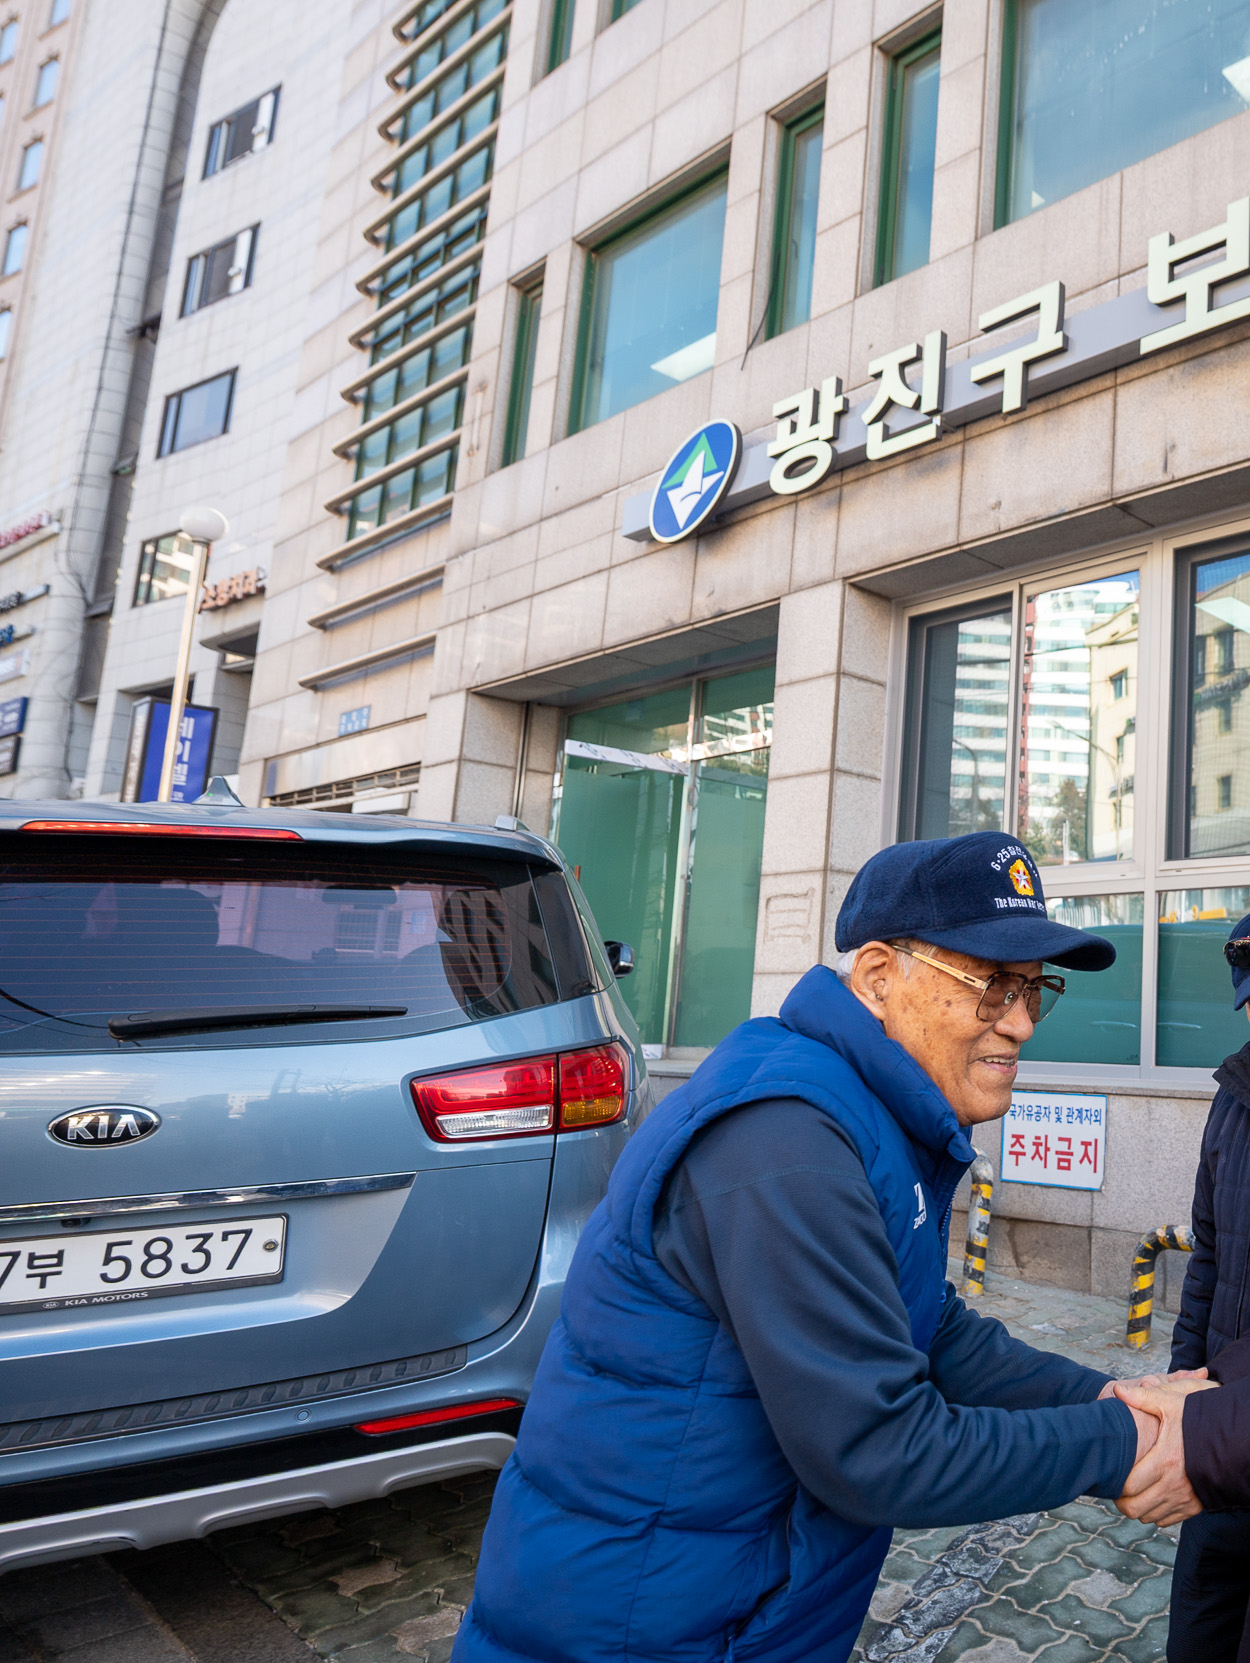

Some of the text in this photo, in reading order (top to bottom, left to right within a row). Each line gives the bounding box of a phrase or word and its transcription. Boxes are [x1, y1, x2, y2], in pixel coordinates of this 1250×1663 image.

[767, 281, 1068, 496] 광진구
[67, 1114, 141, 1140] KIA
[1009, 1103, 1102, 1126] 국가유공자 및 관계자외
[1008, 1133, 1098, 1174] 주차금지
[99, 1227, 254, 1284] 5837
[91, 1291, 149, 1304] MOTORS
